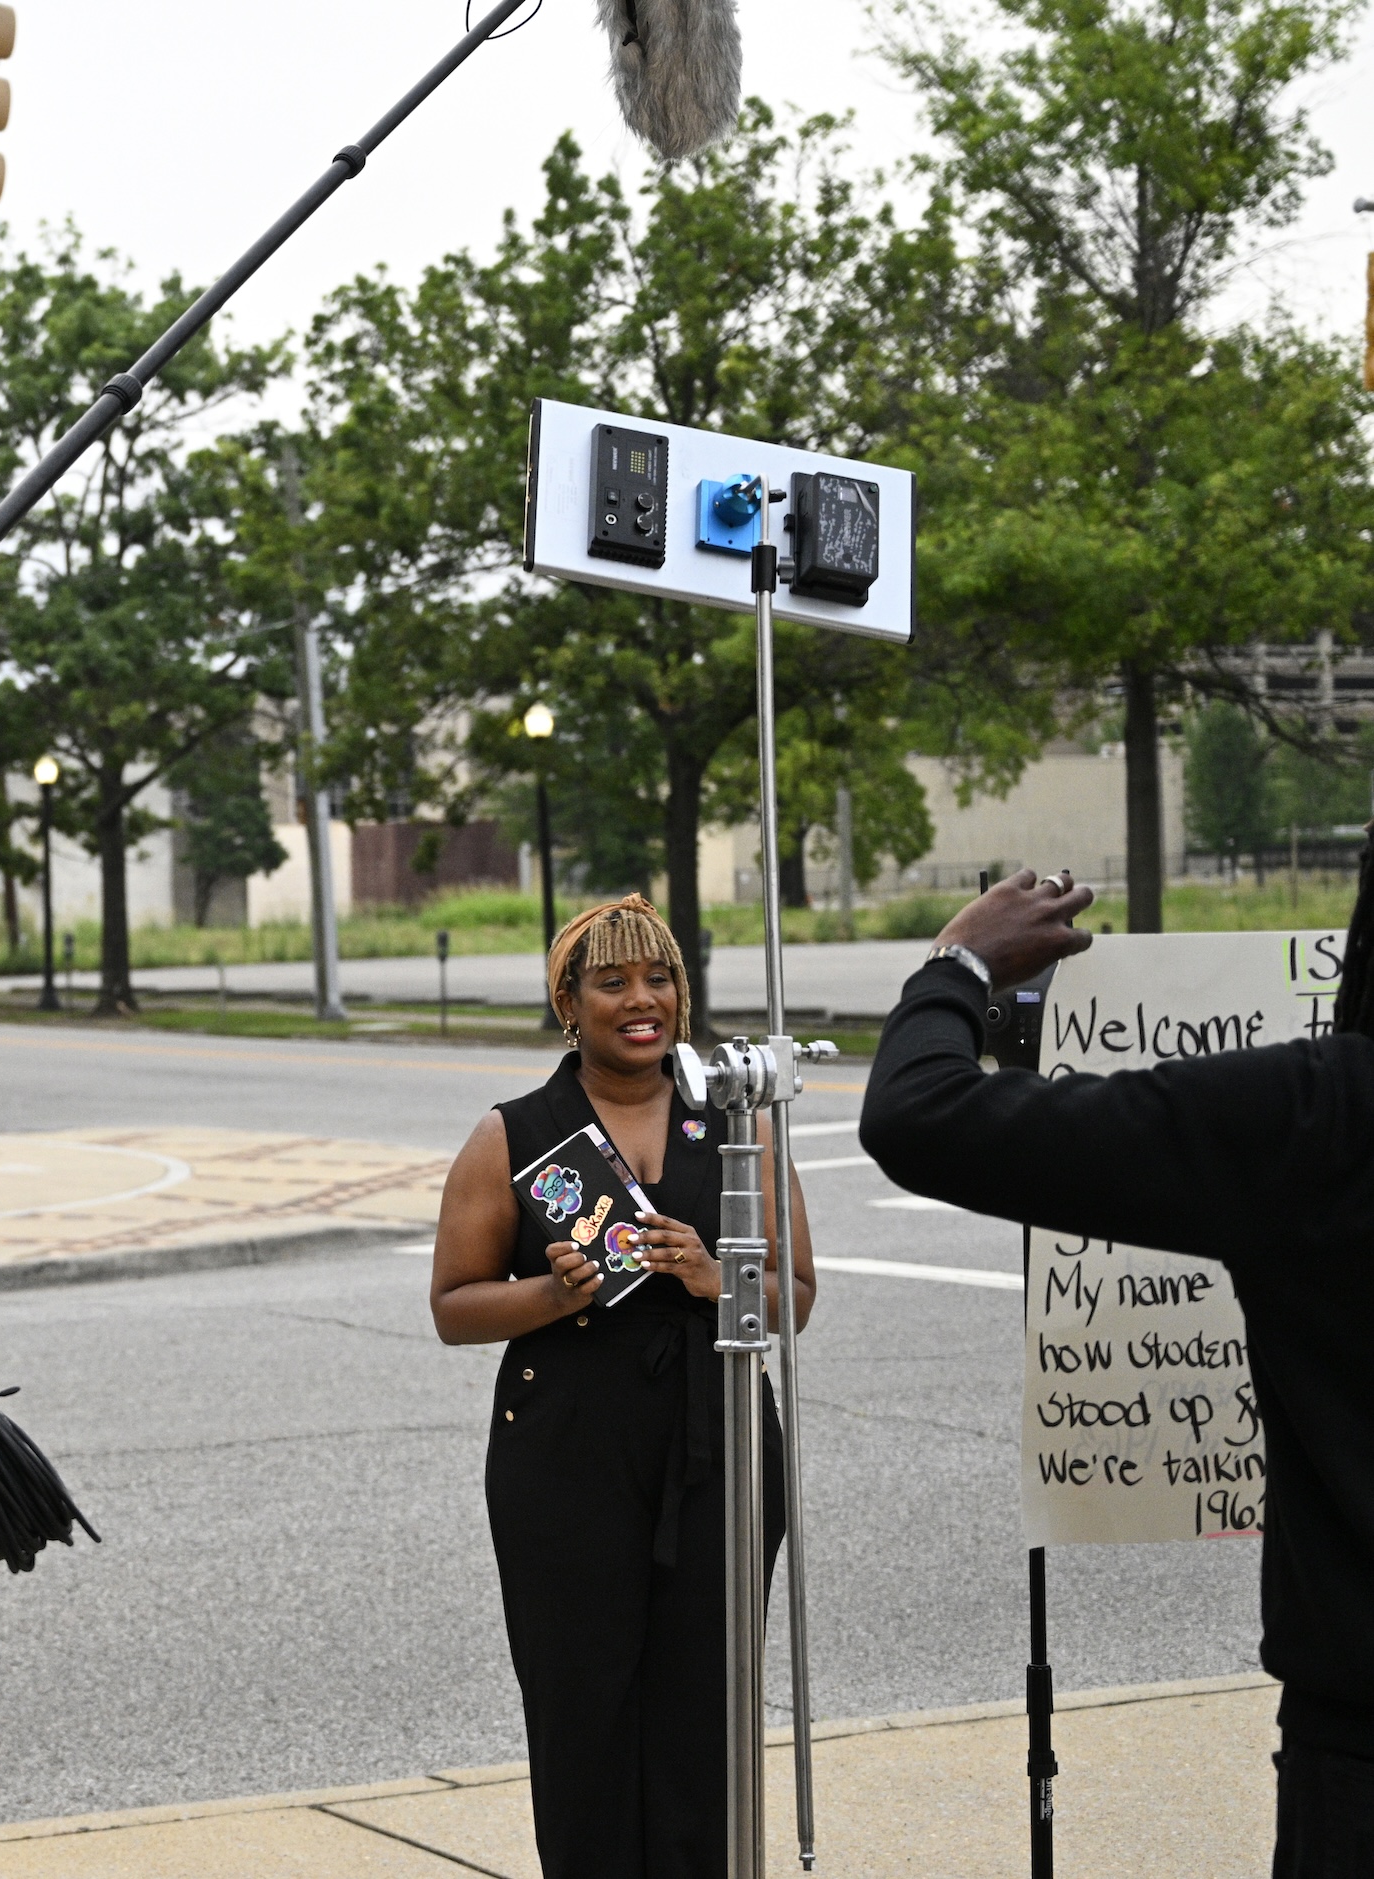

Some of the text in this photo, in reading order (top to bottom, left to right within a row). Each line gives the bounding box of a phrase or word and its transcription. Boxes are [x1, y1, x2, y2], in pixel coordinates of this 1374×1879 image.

[1054, 996, 1264, 1058] Welcome
[1045, 1260, 1214, 1327] My name
[1039, 1332, 1112, 1373] how
